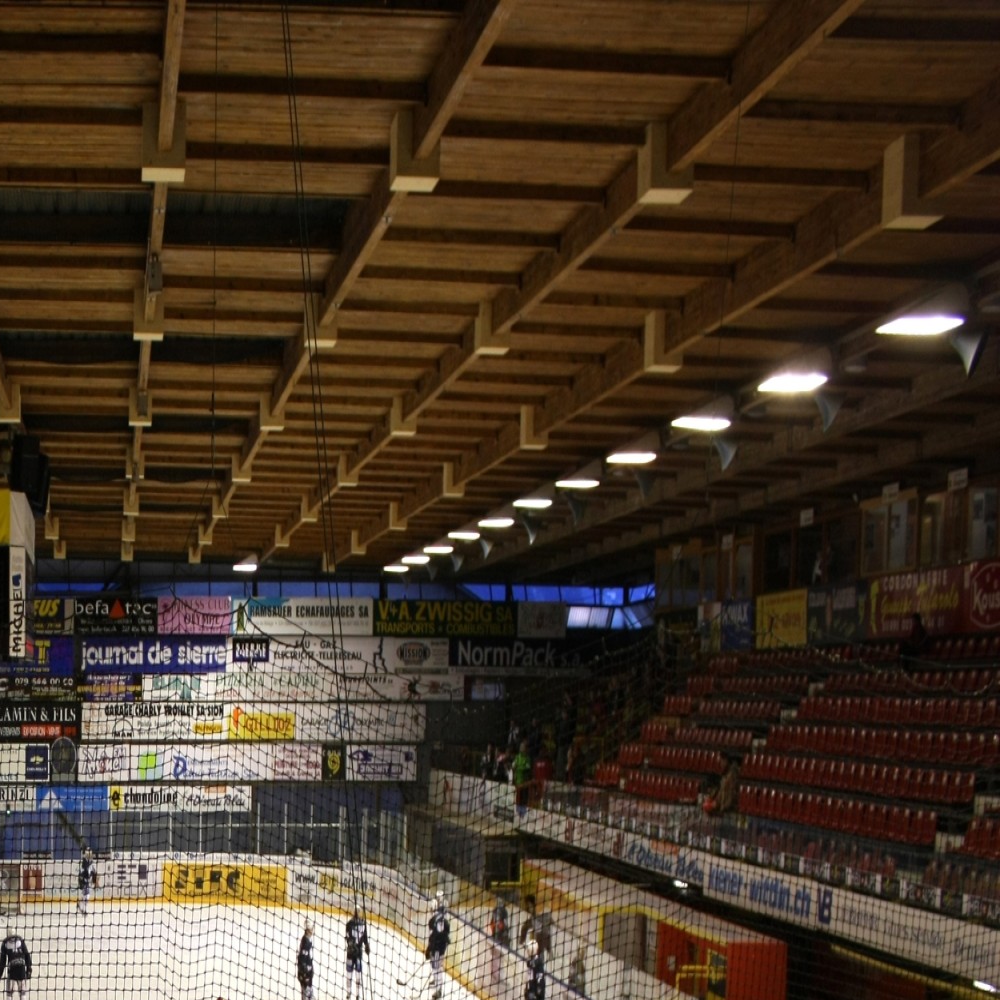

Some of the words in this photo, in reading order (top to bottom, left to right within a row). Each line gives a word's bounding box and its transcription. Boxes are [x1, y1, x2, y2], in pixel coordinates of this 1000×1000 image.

[250, 606, 292, 618] RAMSAUER
[296, 605, 355, 618] ECHAFAUDAGES
[359, 606, 369, 618] SA
[415, 601, 493, 622] ZWISSIG
[495, 606, 513, 621] SA
[376, 622, 435, 633] TRANSPORTS
[81, 641, 143, 670] journal
[148, 641, 172, 665] de
[178, 641, 226, 665] sierre
[457, 640, 556, 667] NormPack
[40, 707, 49, 721] &
[53, 707, 76, 722] FILS
[105, 705, 132, 716] GARAGE
[135, 704, 161, 716] CHARLY
